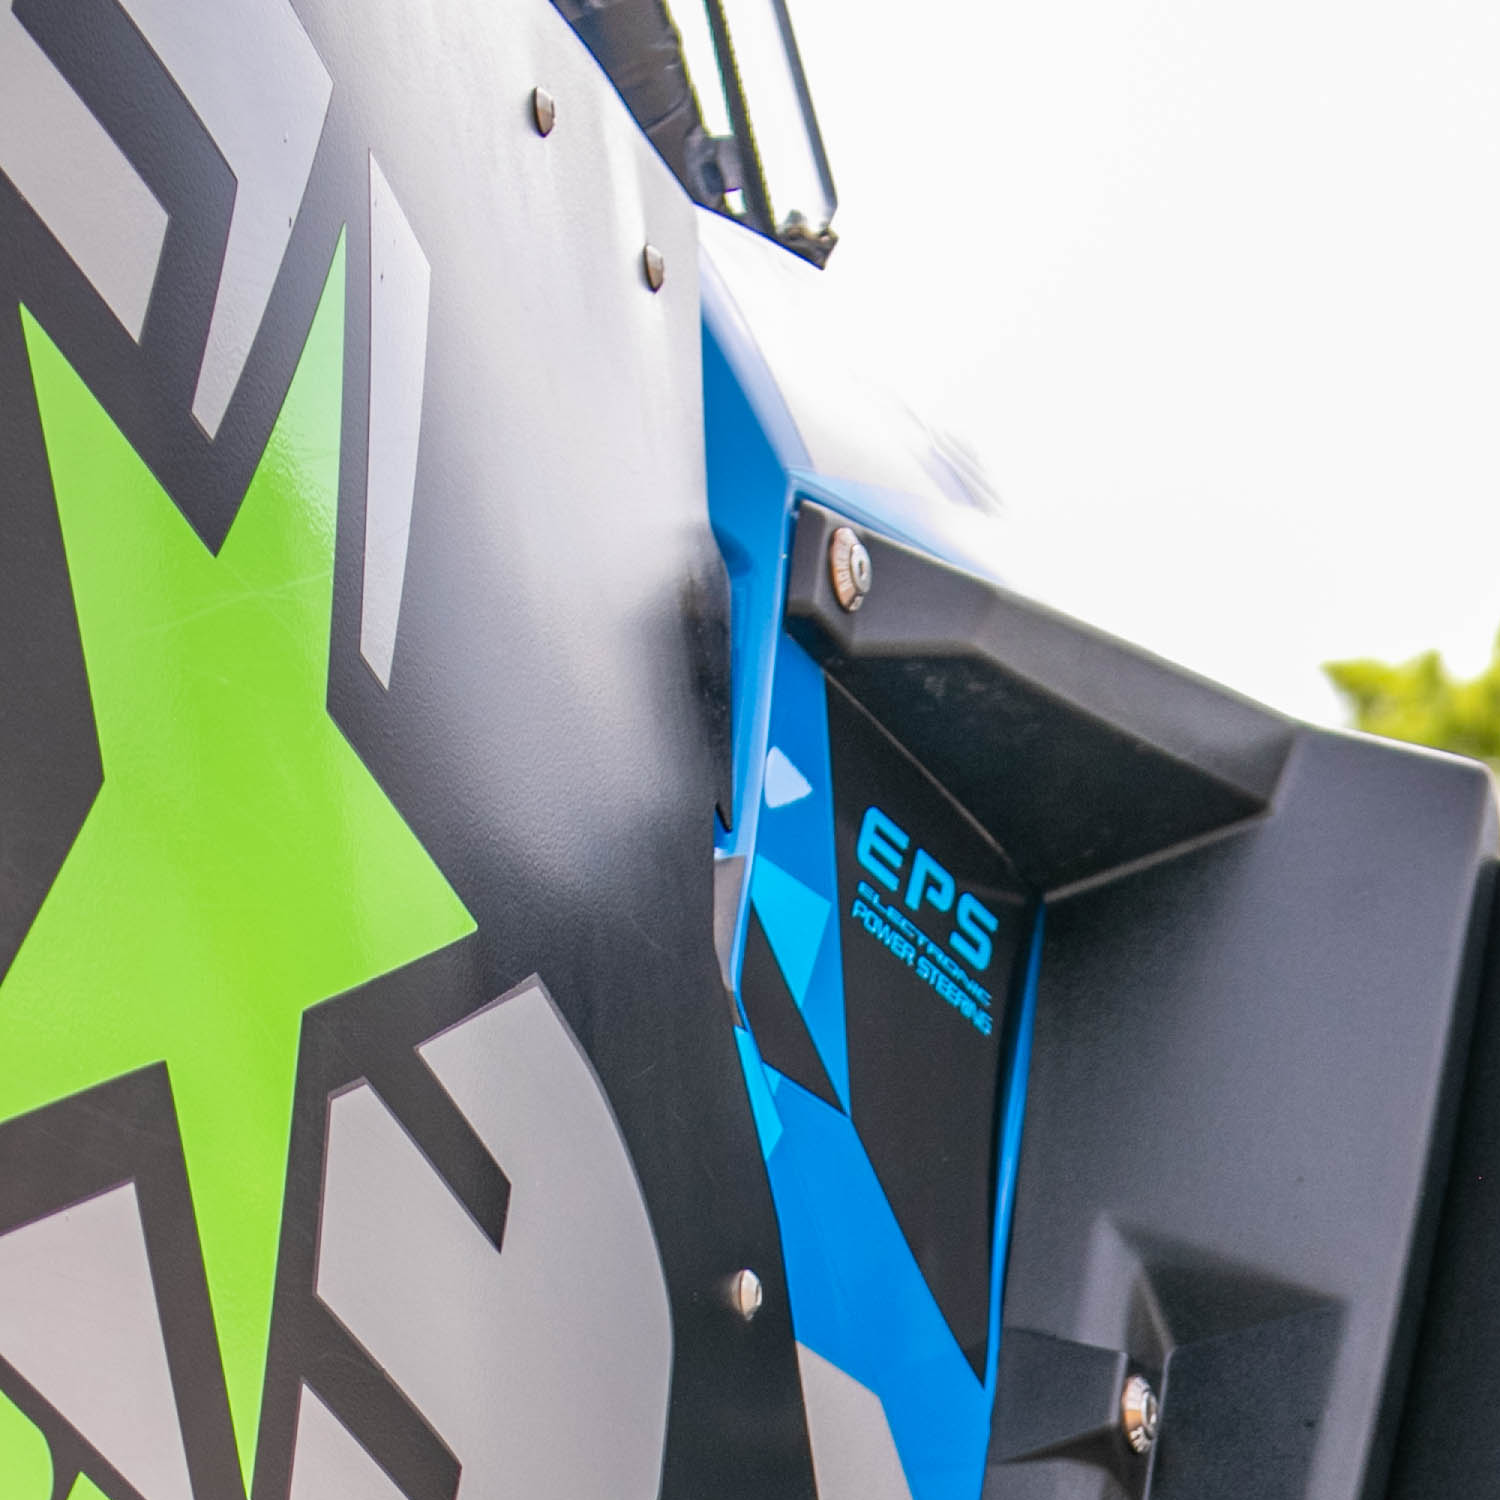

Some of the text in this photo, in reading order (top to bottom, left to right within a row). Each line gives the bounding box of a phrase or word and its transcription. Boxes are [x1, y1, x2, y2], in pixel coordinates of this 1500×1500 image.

[856, 804, 999, 972] EPS
[856, 880, 992, 1008] ELECTRONIC
[852, 898, 993, 1036] POWER STEERING
